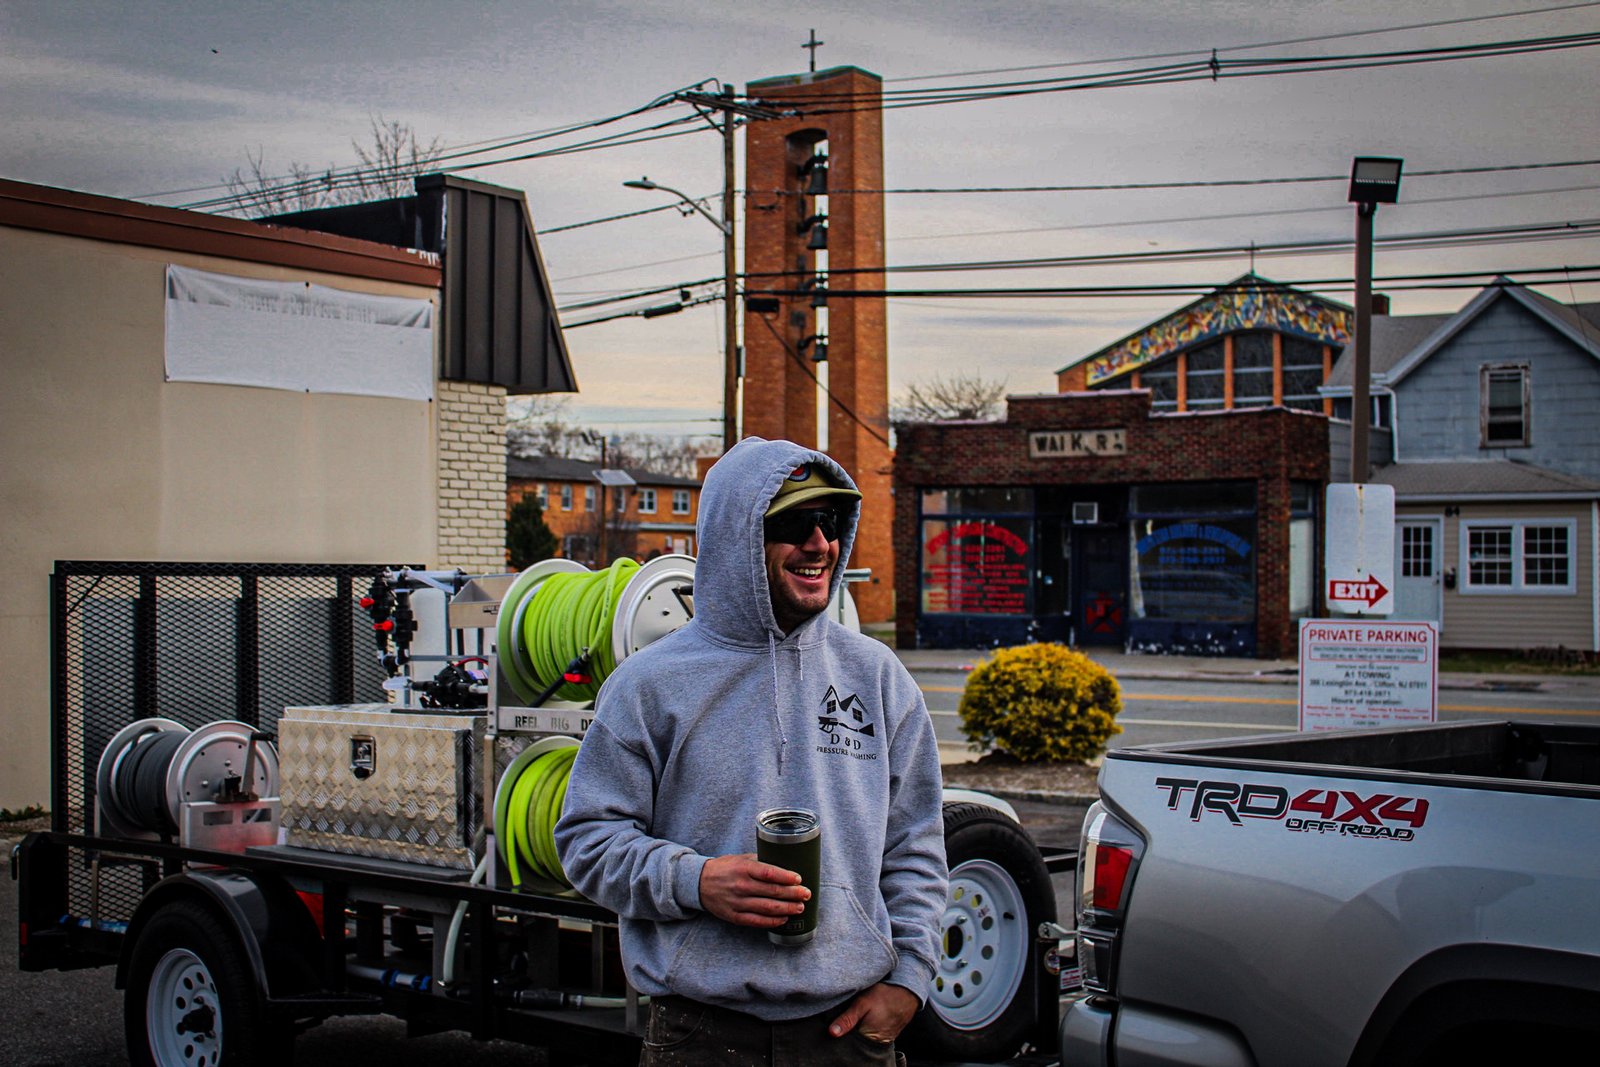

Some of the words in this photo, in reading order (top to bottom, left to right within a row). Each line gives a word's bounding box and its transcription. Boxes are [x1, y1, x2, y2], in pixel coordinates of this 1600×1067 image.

[1334, 583, 1379, 599] EXIT
[1309, 629, 1362, 641] PRIVATE
[1367, 630, 1428, 643] PARKING
[1358, 671, 1391, 680] TOWING
[515, 716, 538, 729] REEL
[551, 717, 570, 731] BIG
[581, 719, 594, 731] D
[830, 733, 841, 745] D
[844, 736, 851, 747] &
[853, 740, 862, 750] D
[816, 745, 849, 755] PRESSURE
[1155, 777, 1290, 827] TRD
[1285, 818, 1338, 834] OFF
[1339, 823, 1415, 842] ROAD
